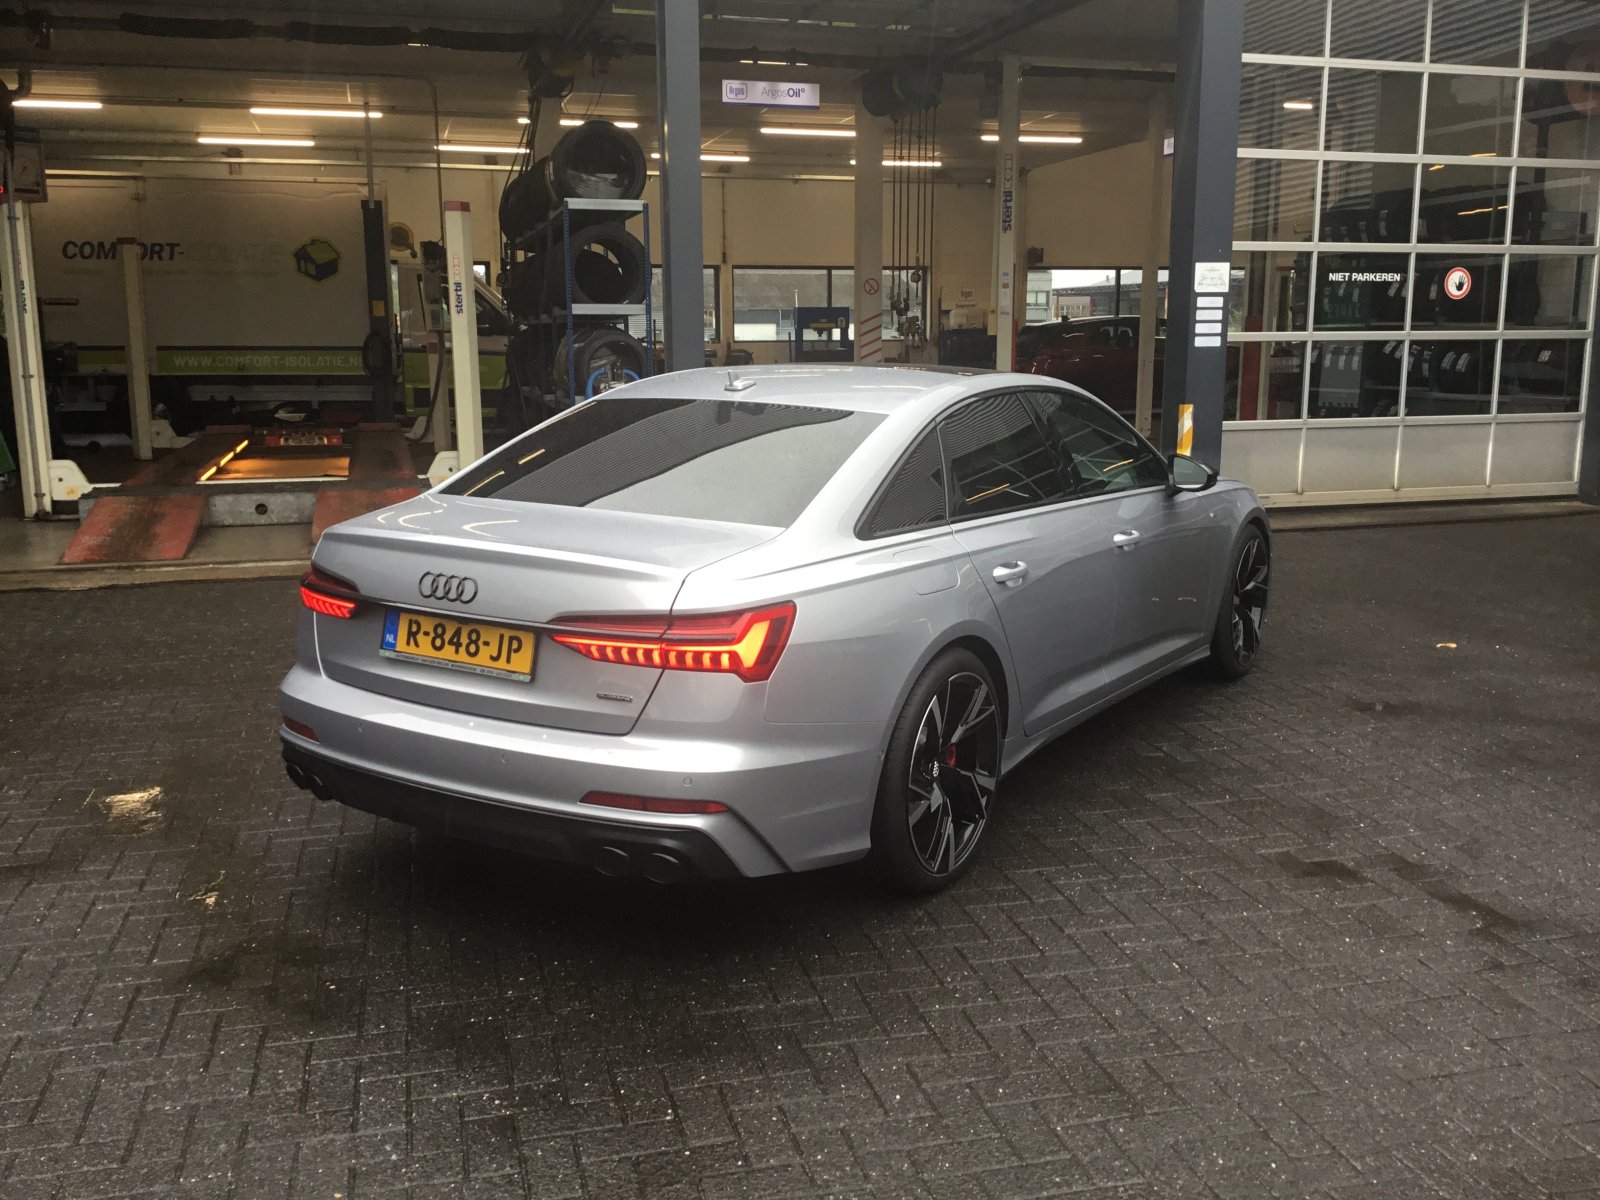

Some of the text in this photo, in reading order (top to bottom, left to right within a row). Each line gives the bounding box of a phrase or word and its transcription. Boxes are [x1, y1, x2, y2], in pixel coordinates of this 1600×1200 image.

[1002, 191, 1013, 233] stertil
[1328, 272, 1401, 282] NIET PARKEREN
[453, 282, 464, 315] stertil
[385, 634, 396, 644] NL
[405, 618, 524, 665] R-848-JP
